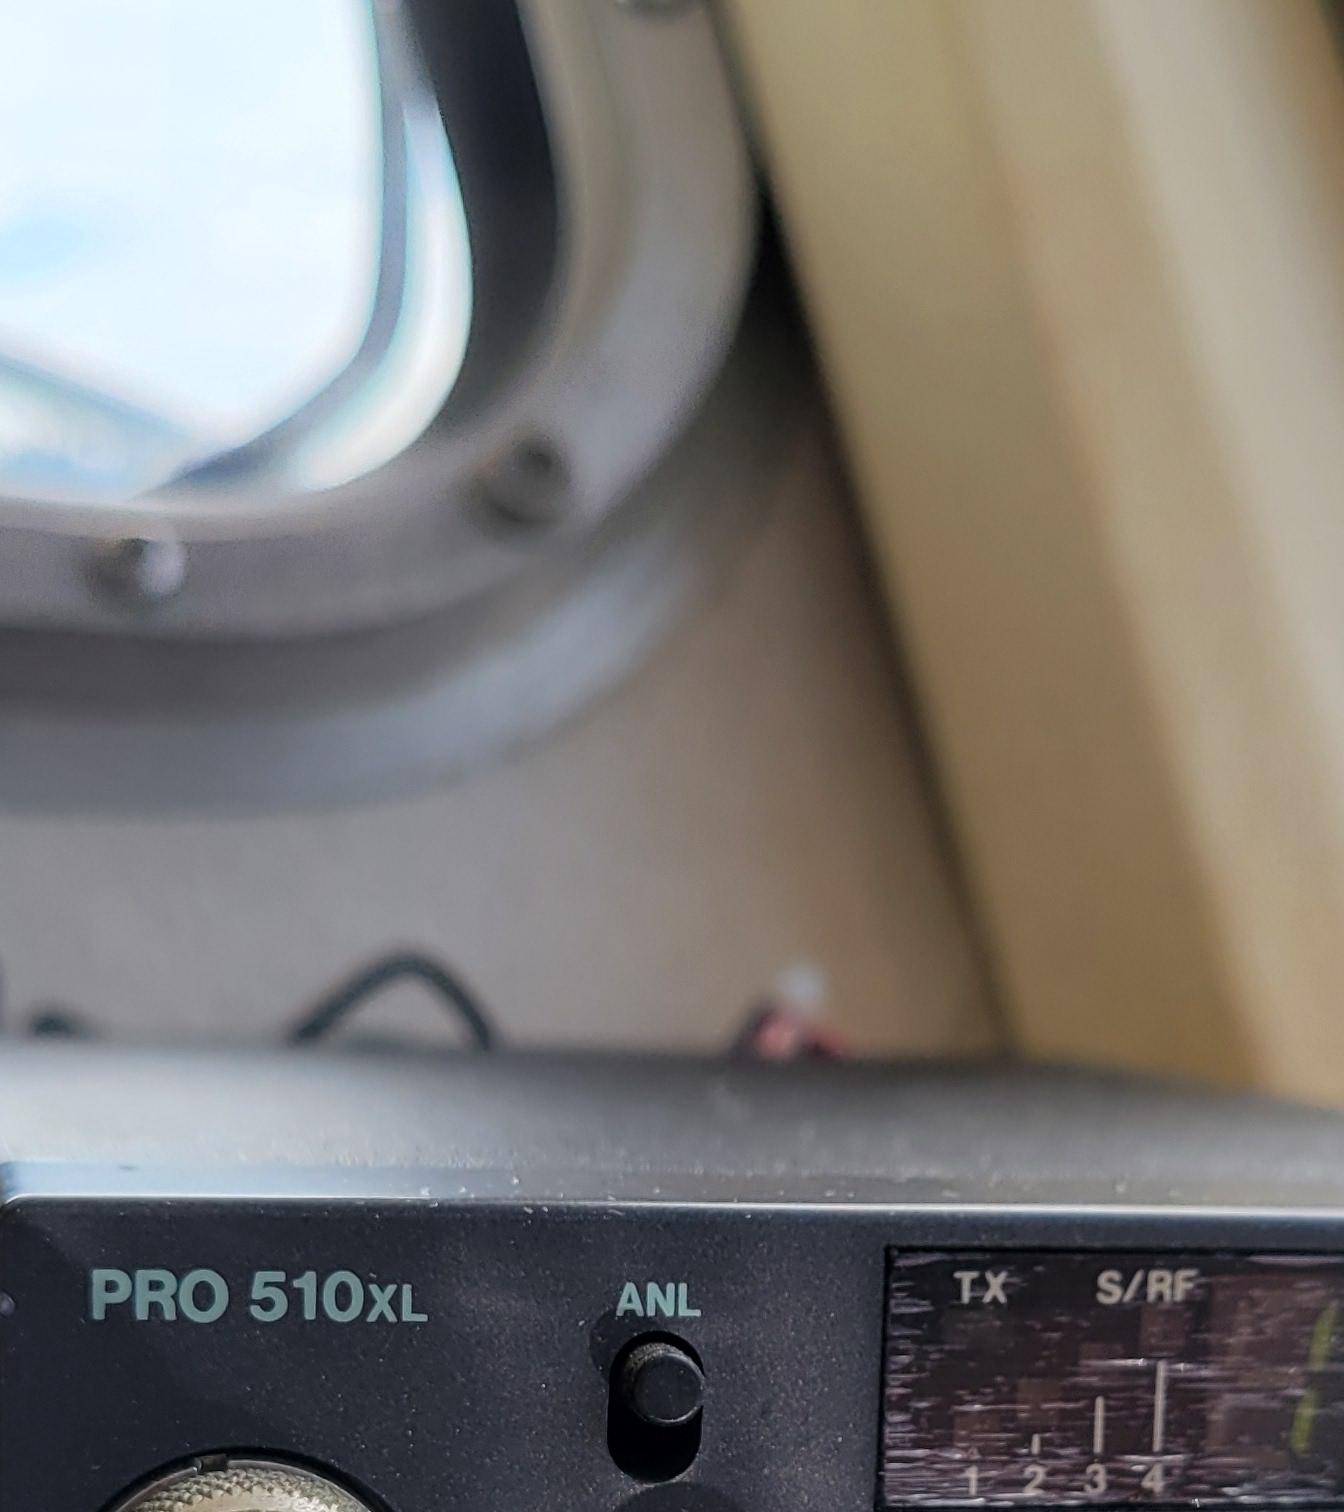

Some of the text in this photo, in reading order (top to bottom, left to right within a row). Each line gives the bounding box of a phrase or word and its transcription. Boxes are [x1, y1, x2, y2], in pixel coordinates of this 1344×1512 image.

[91, 1268, 230, 1323] PRO
[616, 1282, 701, 1318] ANL
[953, 1270, 1008, 1304] TX
[1096, 1269, 1199, 1304] S/RF
[959, 1462, 1165, 1496] 1 2 3 4
